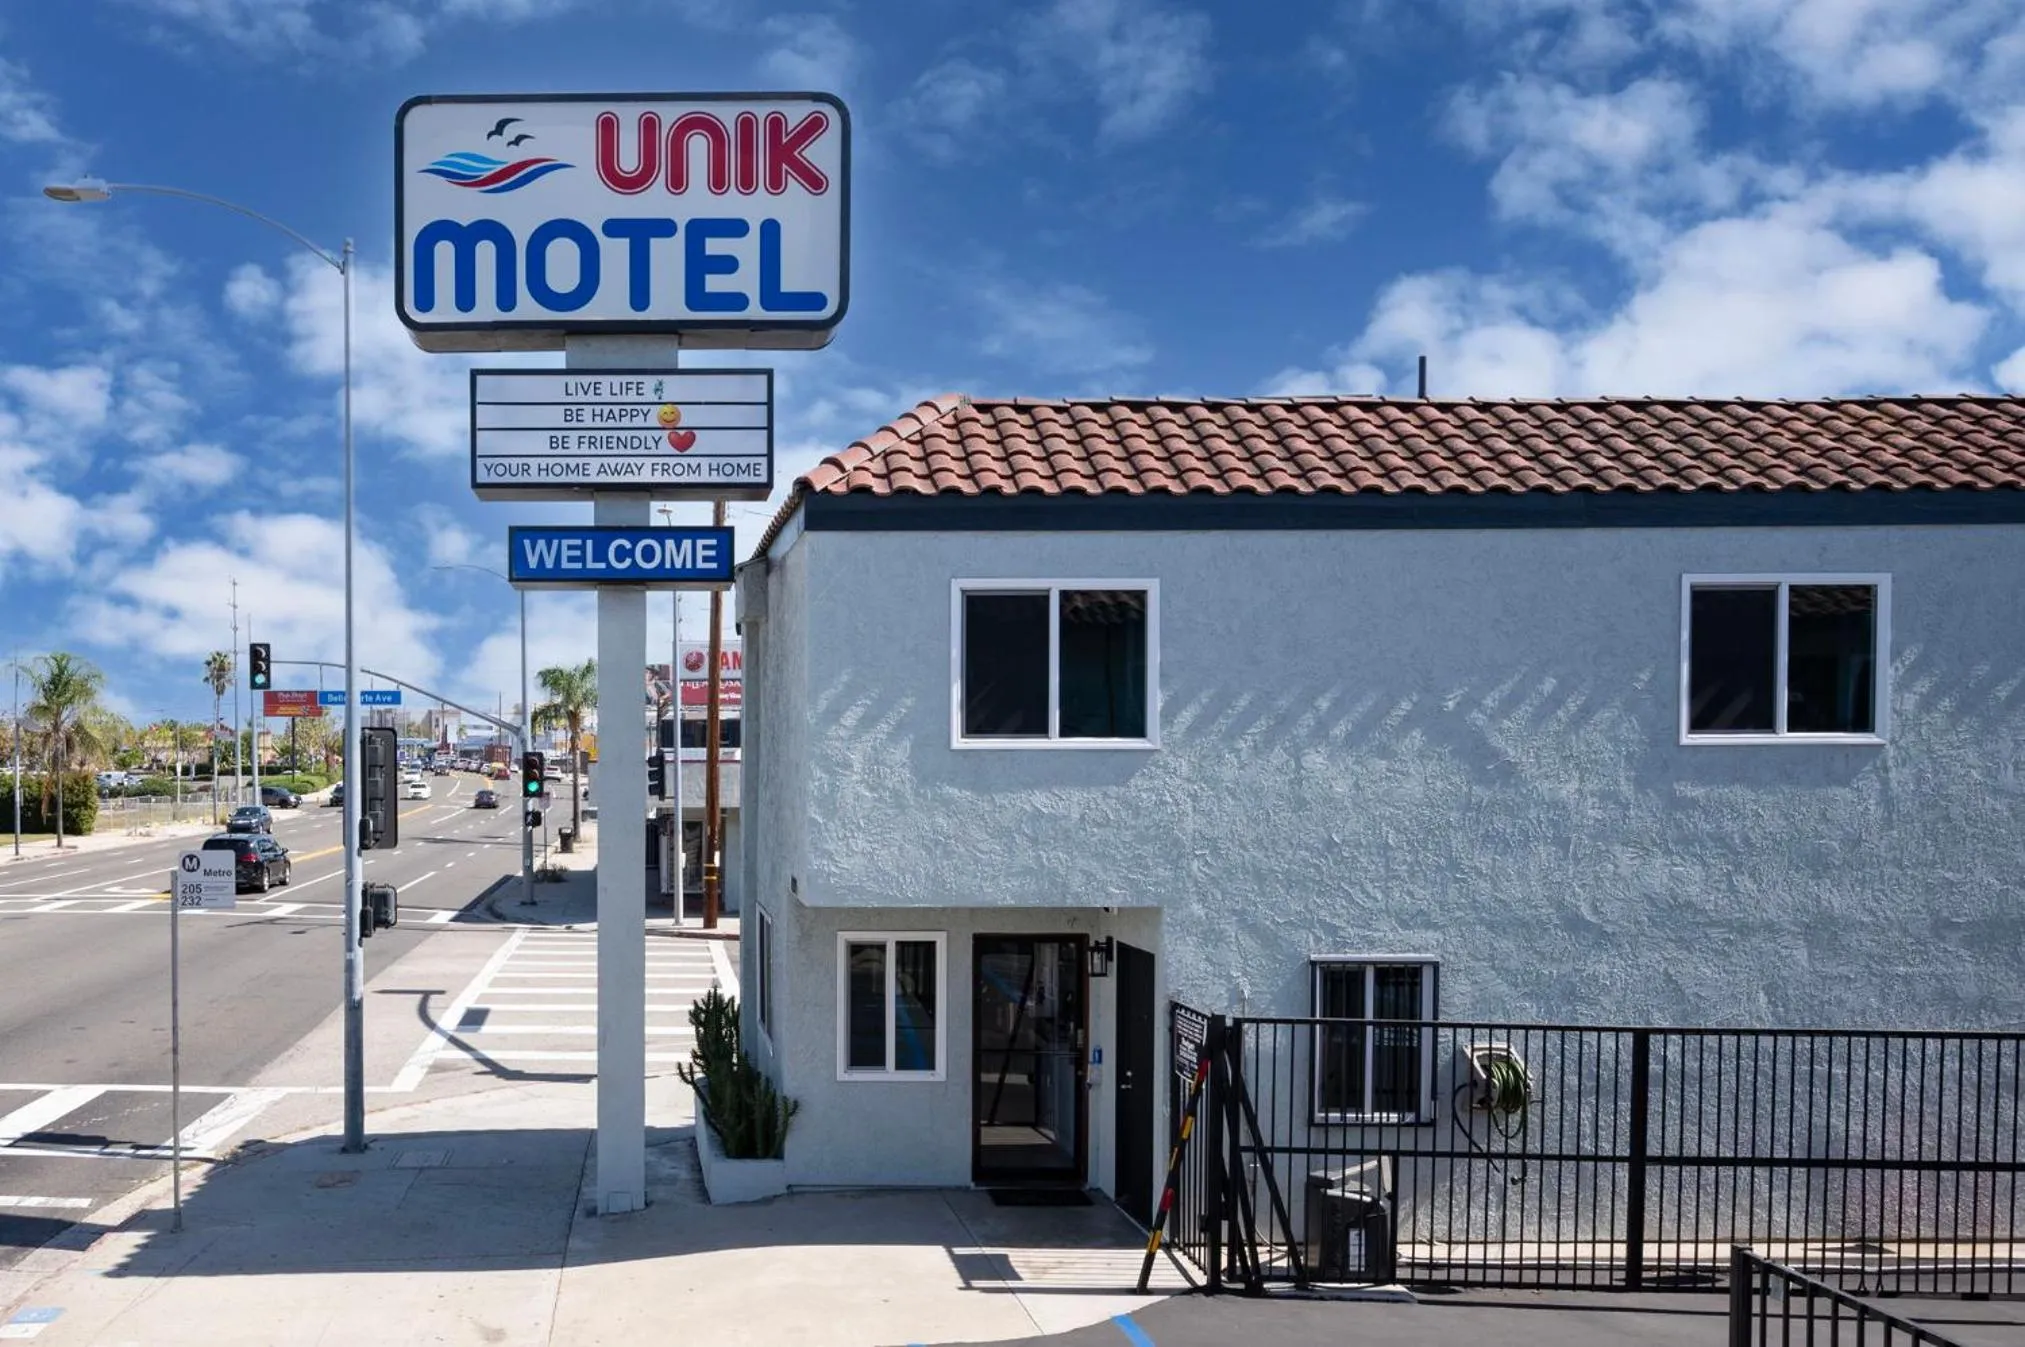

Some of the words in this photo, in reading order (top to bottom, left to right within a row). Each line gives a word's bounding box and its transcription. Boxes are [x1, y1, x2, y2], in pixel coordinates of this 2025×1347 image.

[596, 111, 829, 196] UNIK
[413, 218, 828, 313] MOTEL
[564, 382, 602, 396] LIVE
[609, 382, 645, 396] LIFE
[563, 409, 584, 423] BE
[592, 409, 650, 422] HAPPY
[549, 436, 570, 450] BE
[577, 435, 662, 450] FRIENDLY
[484, 463, 531, 477] YOUR
[537, 463, 590, 477] HOME
[596, 463, 645, 477] AWAY
[651, 463, 701, 477] FROM
[708, 463, 762, 477] HOME
[523, 538, 718, 569] WELCOME
[374, 693, 393, 703] Ave
[203, 868, 232, 877] Metro
[181, 883, 202, 894] 205
[181, 895, 202, 906] 232
